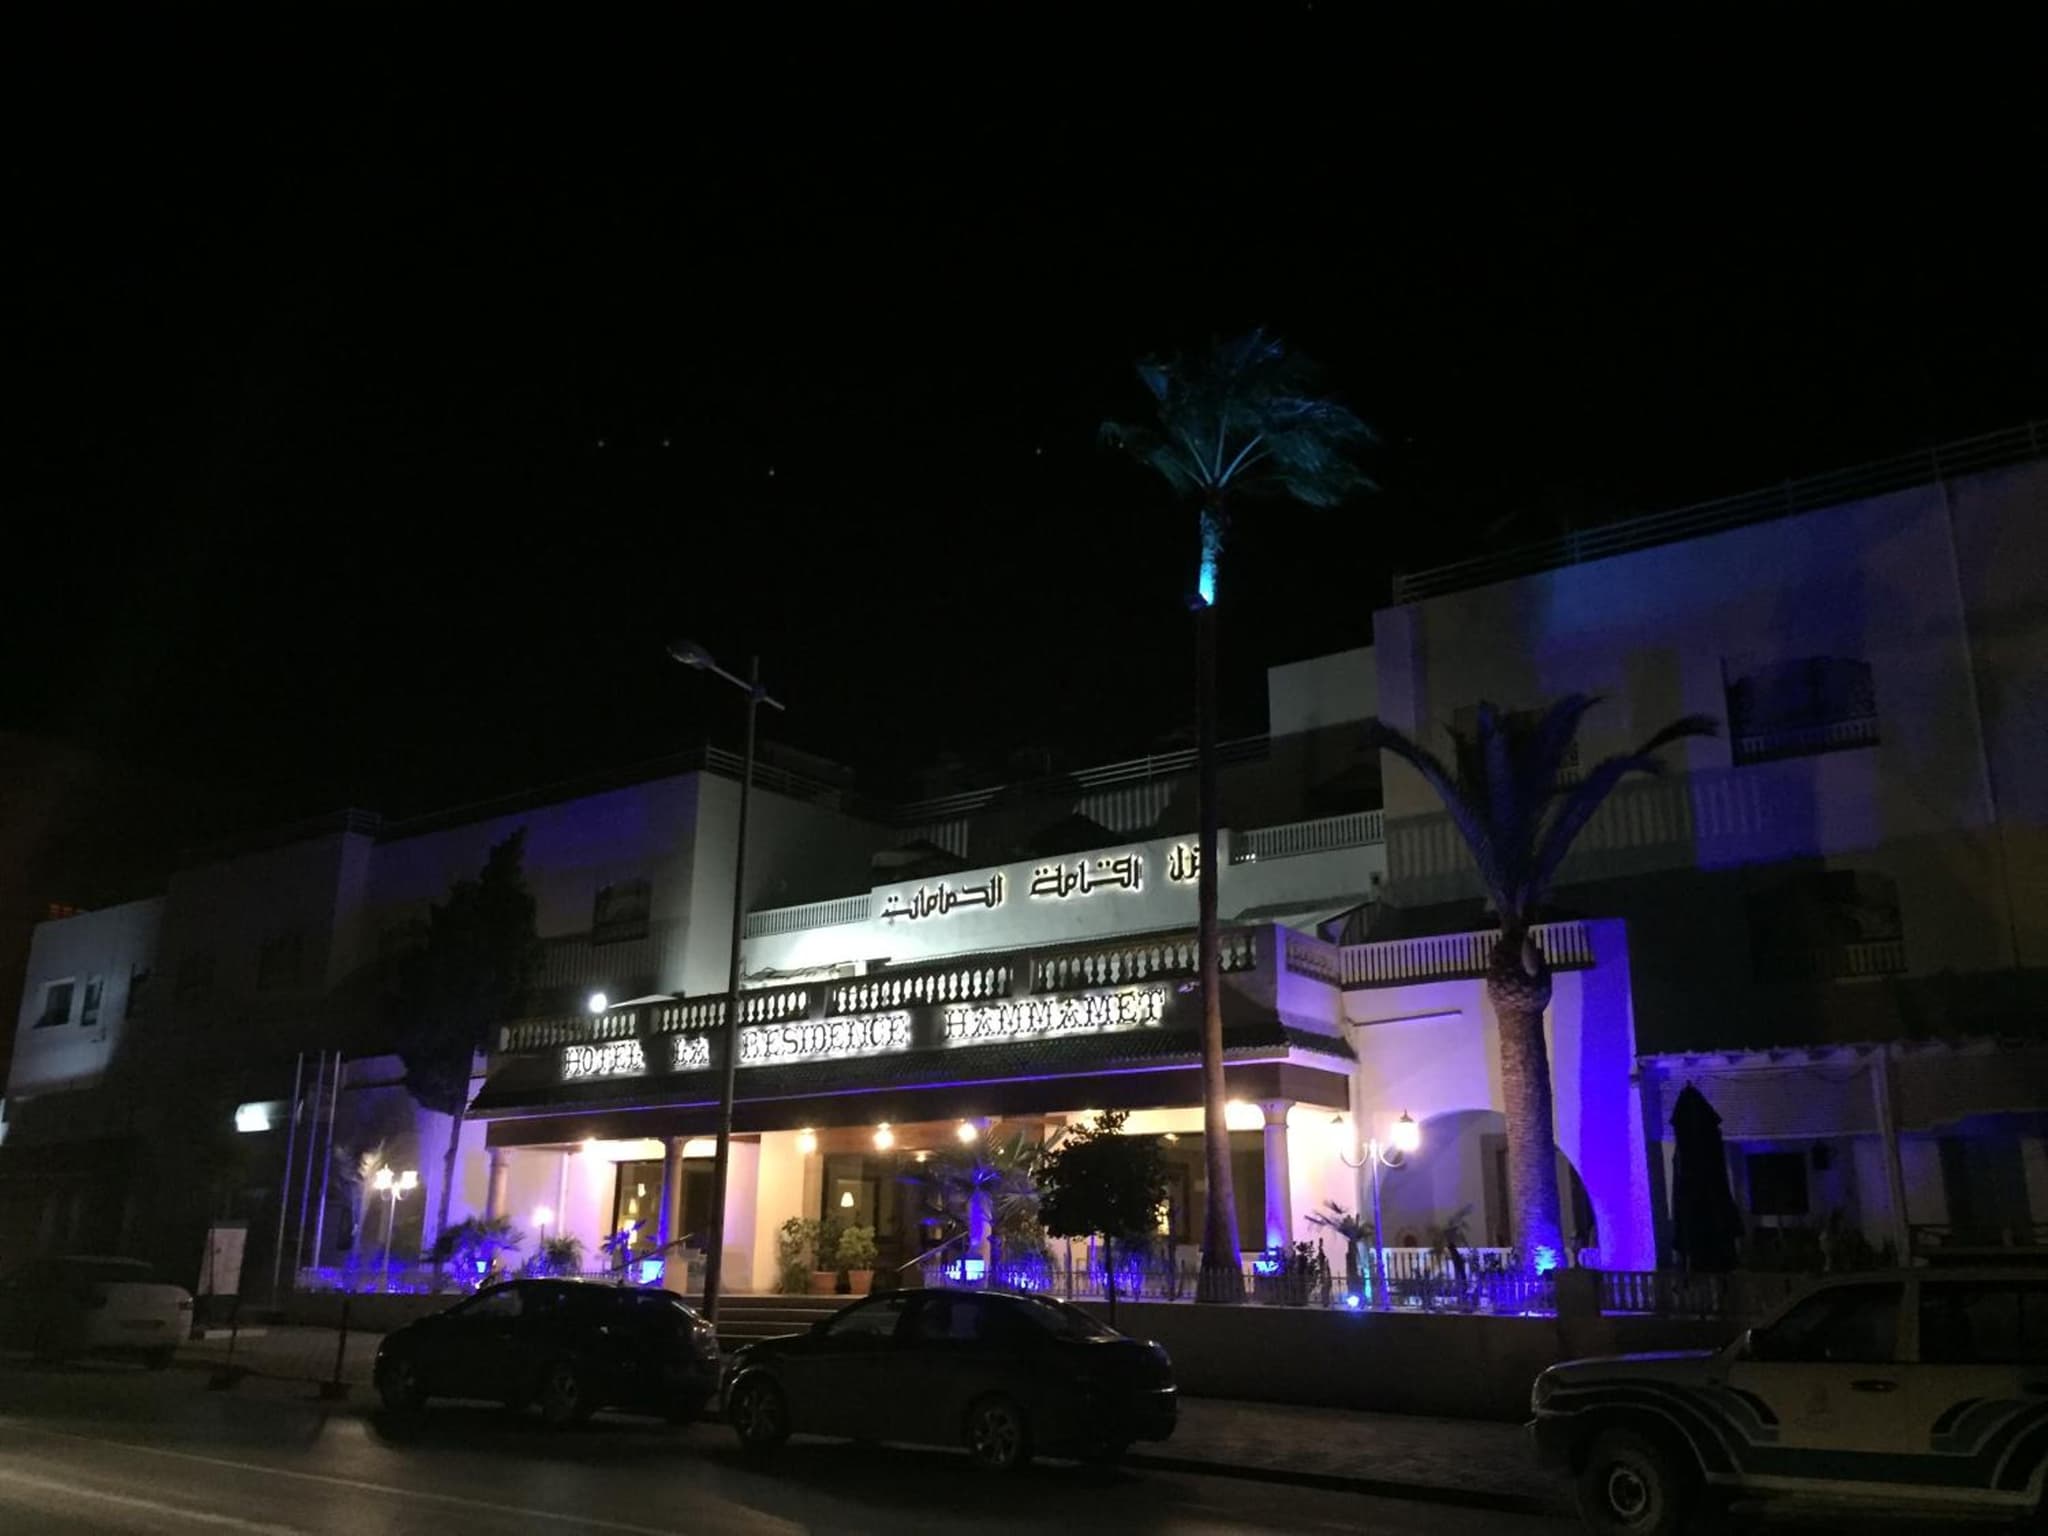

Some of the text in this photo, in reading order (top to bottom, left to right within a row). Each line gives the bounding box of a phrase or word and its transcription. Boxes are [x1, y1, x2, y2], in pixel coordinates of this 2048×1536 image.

[880, 873, 1004, 920] الحمامات
[562, 988, 1167, 1076] HOTEL LA RESIDENCE HAMMAMET
